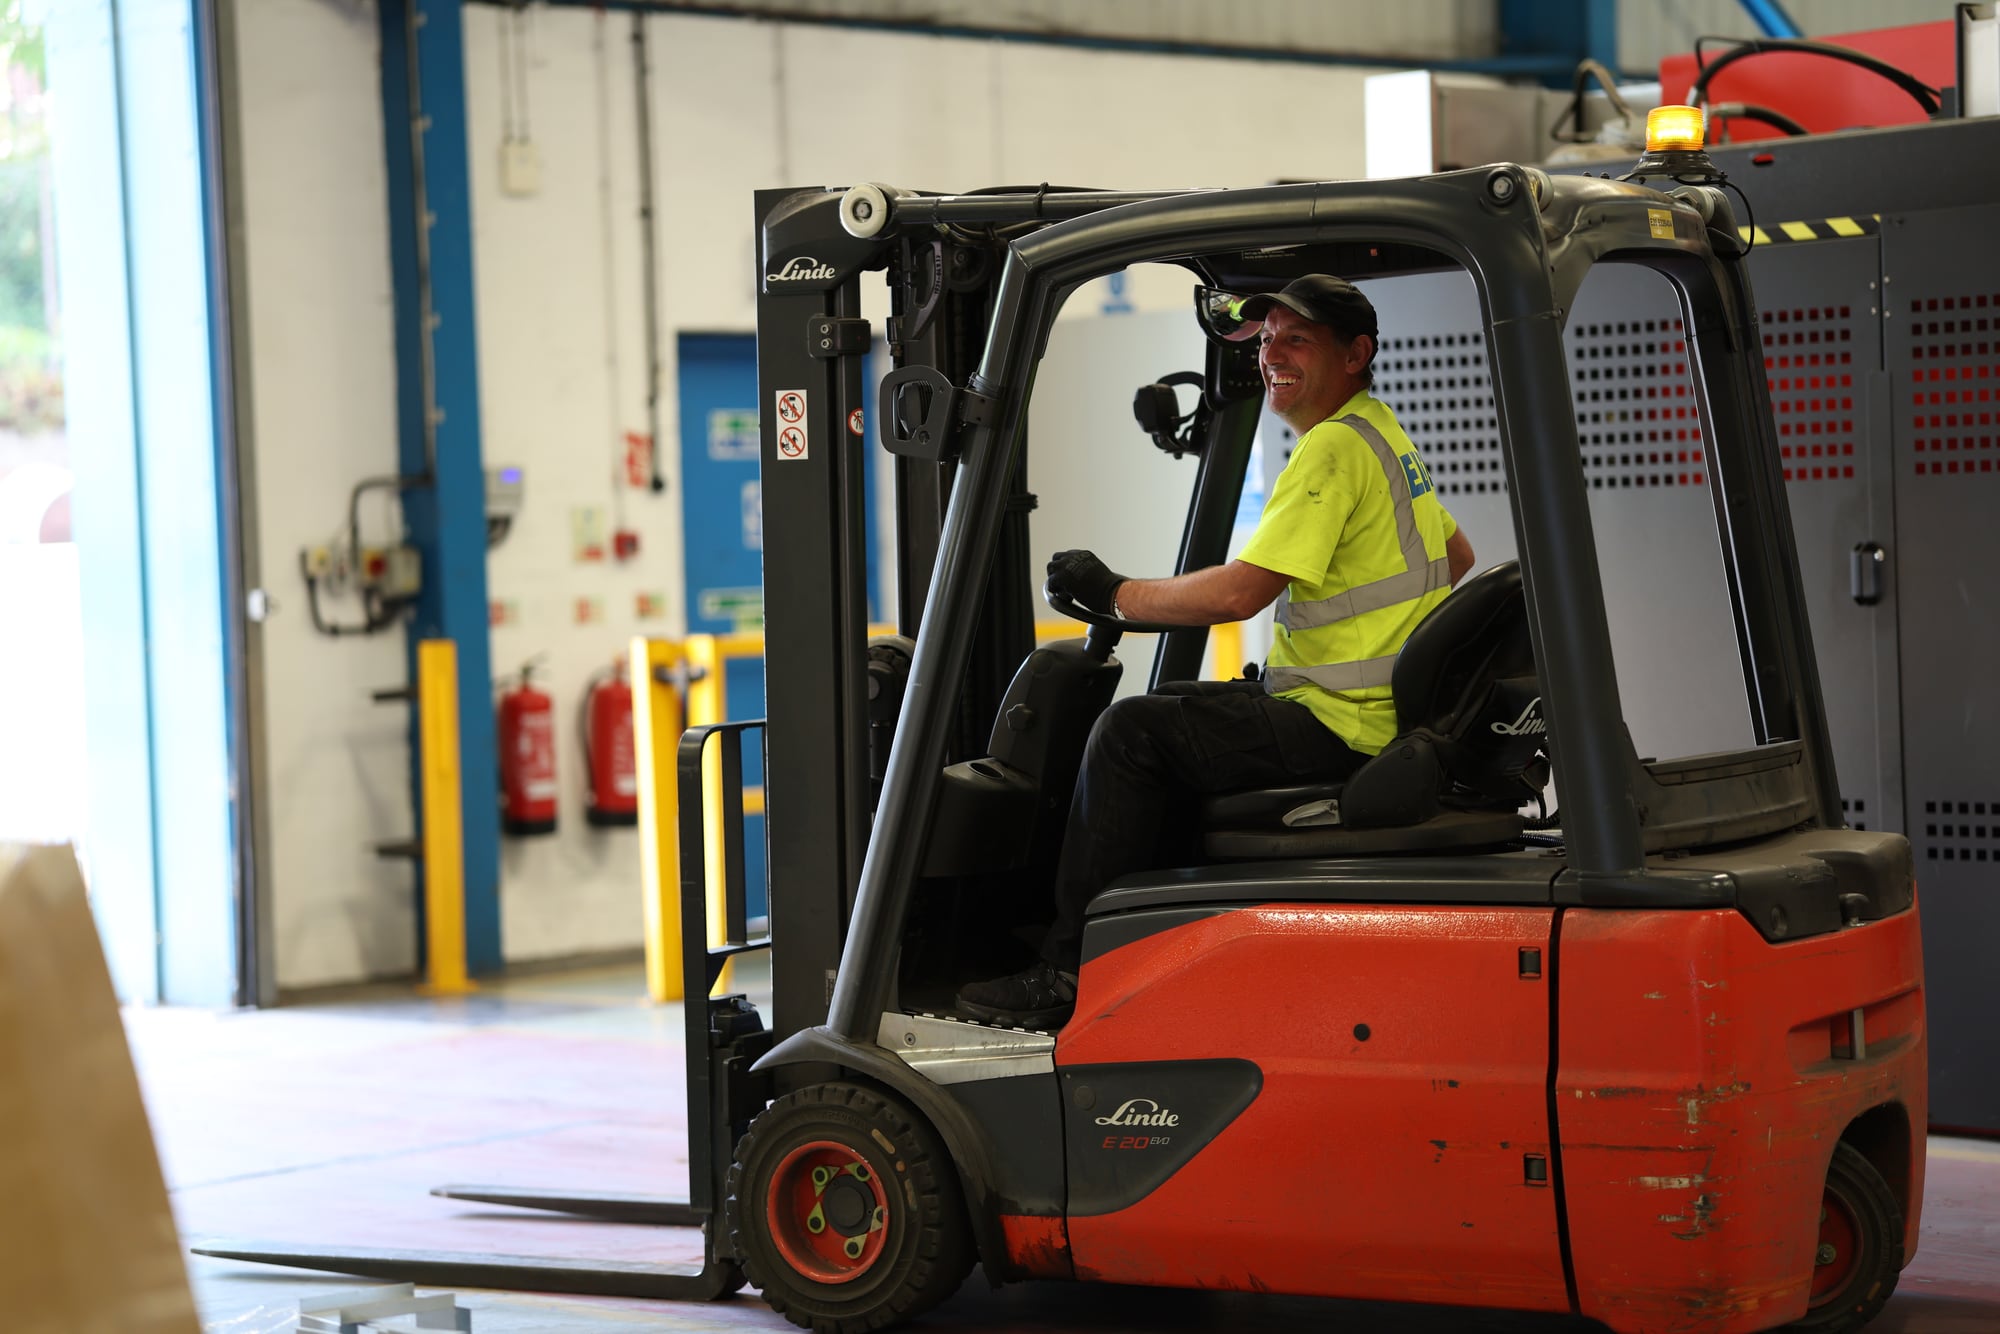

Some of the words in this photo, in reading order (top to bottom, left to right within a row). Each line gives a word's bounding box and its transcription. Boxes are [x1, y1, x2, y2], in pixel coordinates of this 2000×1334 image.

[766, 256, 836, 281] Linde
[1095, 1098, 1179, 1127] Linde
[1102, 1136, 1118, 1149] E
